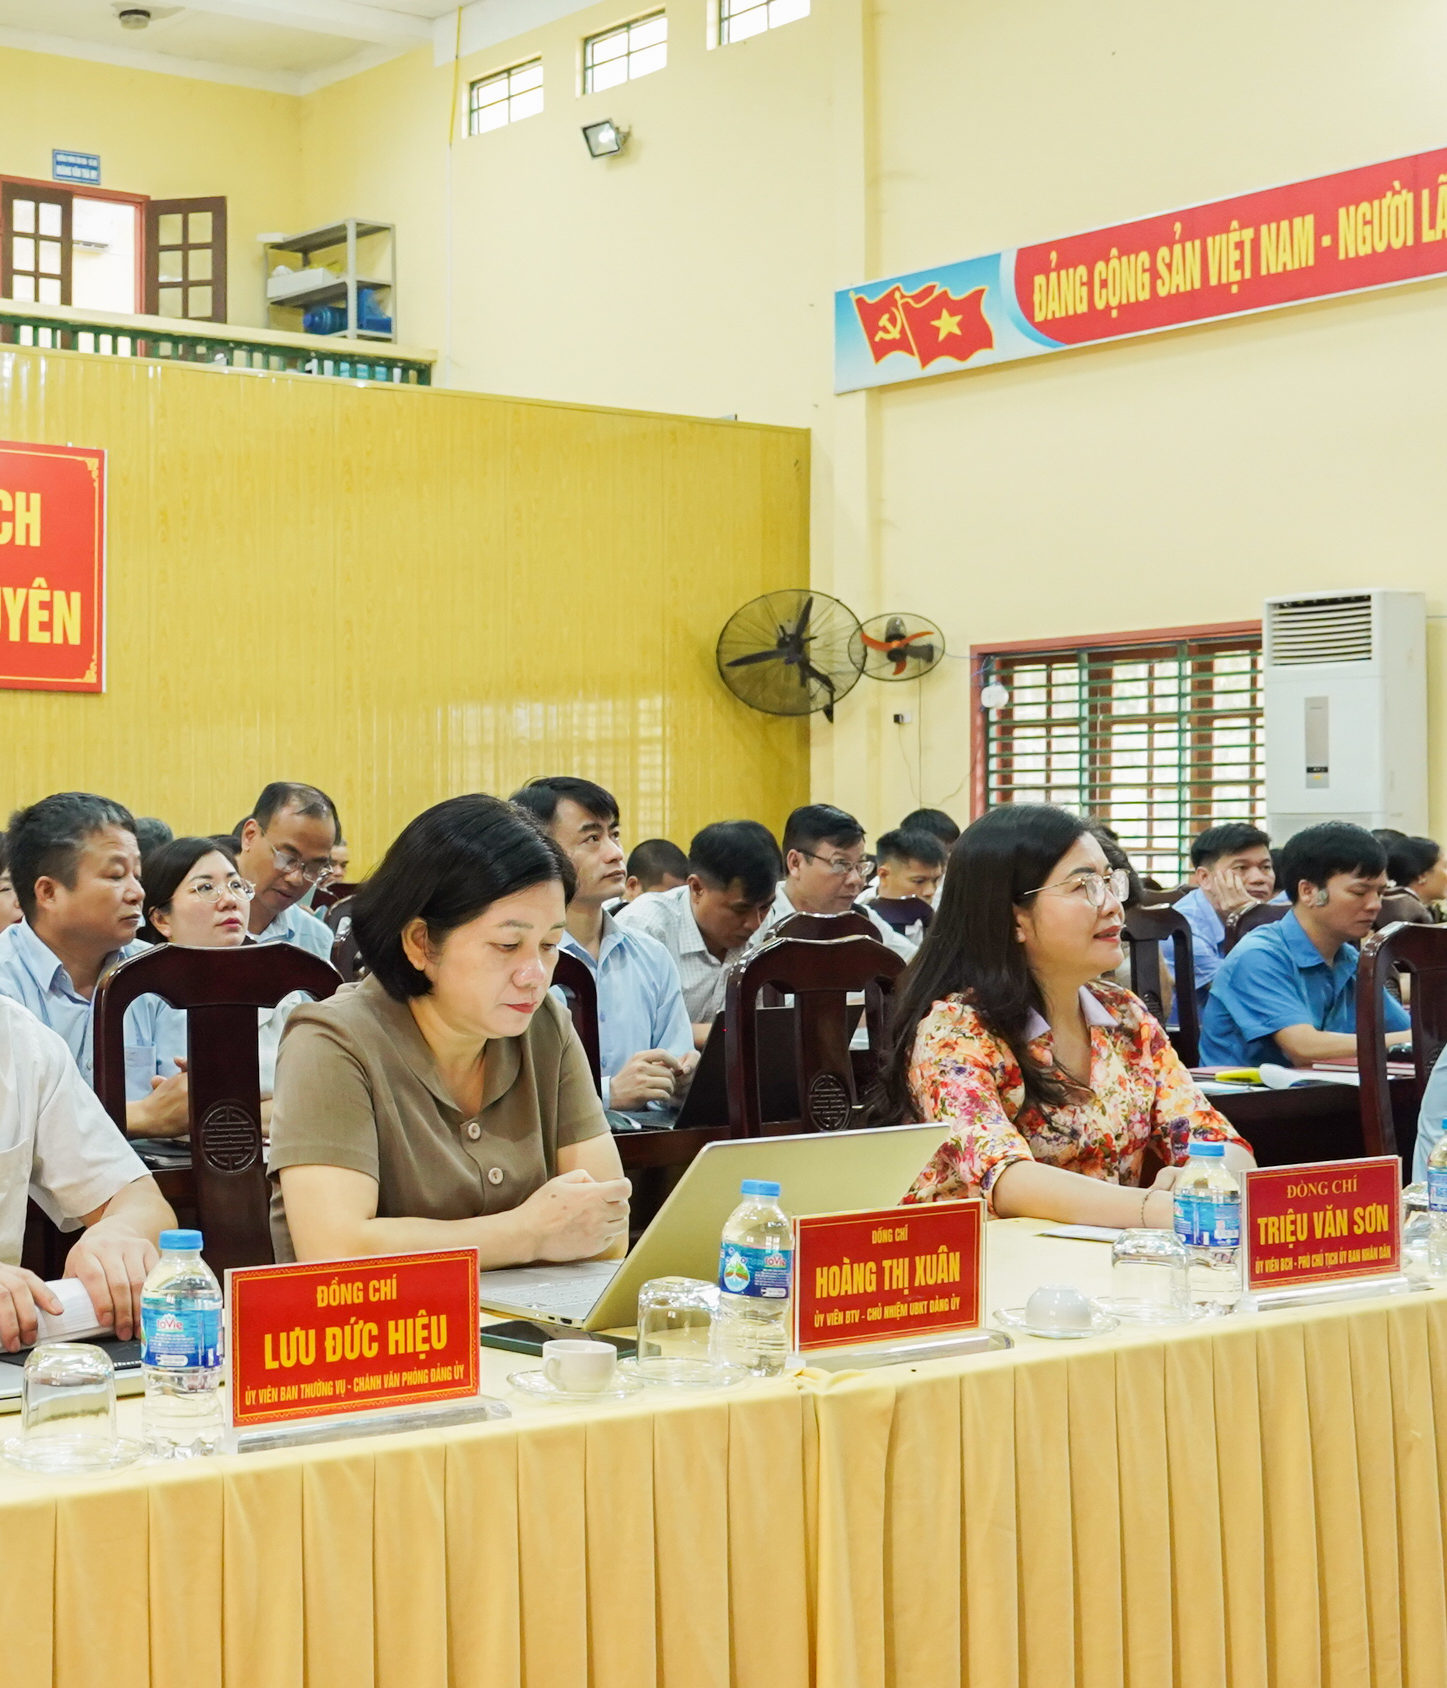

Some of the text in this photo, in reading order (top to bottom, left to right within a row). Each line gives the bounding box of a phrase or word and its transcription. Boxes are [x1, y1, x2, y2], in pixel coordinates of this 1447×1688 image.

[1033, 250, 1088, 323] ĐẢNG
[1093, 248, 1151, 318] CỘNG
[1156, 222, 1201, 298] SẢN
[1207, 220, 1254, 294] VIỆT
[1260, 214, 1315, 276] NAM
[1321, 235, 1331, 247] -
[1338, 181, 1414, 260] NGƯỜI
[1332, 1175, 1358, 1193] CHÍ
[895, 1224, 908, 1241] CHÍ
[1257, 1209, 1308, 1248] TRIỆU
[1313, 1204, 1348, 1239] VĂN
[1354, 1203, 1388, 1235] SƠN
[317, 1274, 397, 1307] ĐỒNG CHÍ
[815, 1257, 876, 1298] HOÀNG
[882, 1257, 909, 1295] THỊ
[914, 1245, 960, 1287] XUÂN
[814, 1310, 824, 1328] ỦY
[826, 1309, 843, 1326] VIÊN
[845, 1310, 860, 1324] BTV
[867, 1303, 882, 1321] CHỦ
[884, 1302, 907, 1320] NHIỆM
[910, 1301, 928, 1315] UBKT
[951, 1293, 960, 1310] ỦY
[264, 1310, 447, 1369] LƯU ĐỨC HIỆU
[245, 1385, 256, 1406] ỦY
[258, 1385, 278, 1404] VIÊN
[280, 1385, 298, 1401] BAN
[300, 1378, 333, 1399] THƯỜNG
[335, 1379, 346, 1397] VỤ
[353, 1372, 381, 1391] CHÁNH
[384, 1371, 400, 1388] VĂN
[402, 1367, 428, 1385] PHÒNG
[431, 1363, 452, 1382] ĐẢNG
[454, 1360, 464, 1380] ỦY
